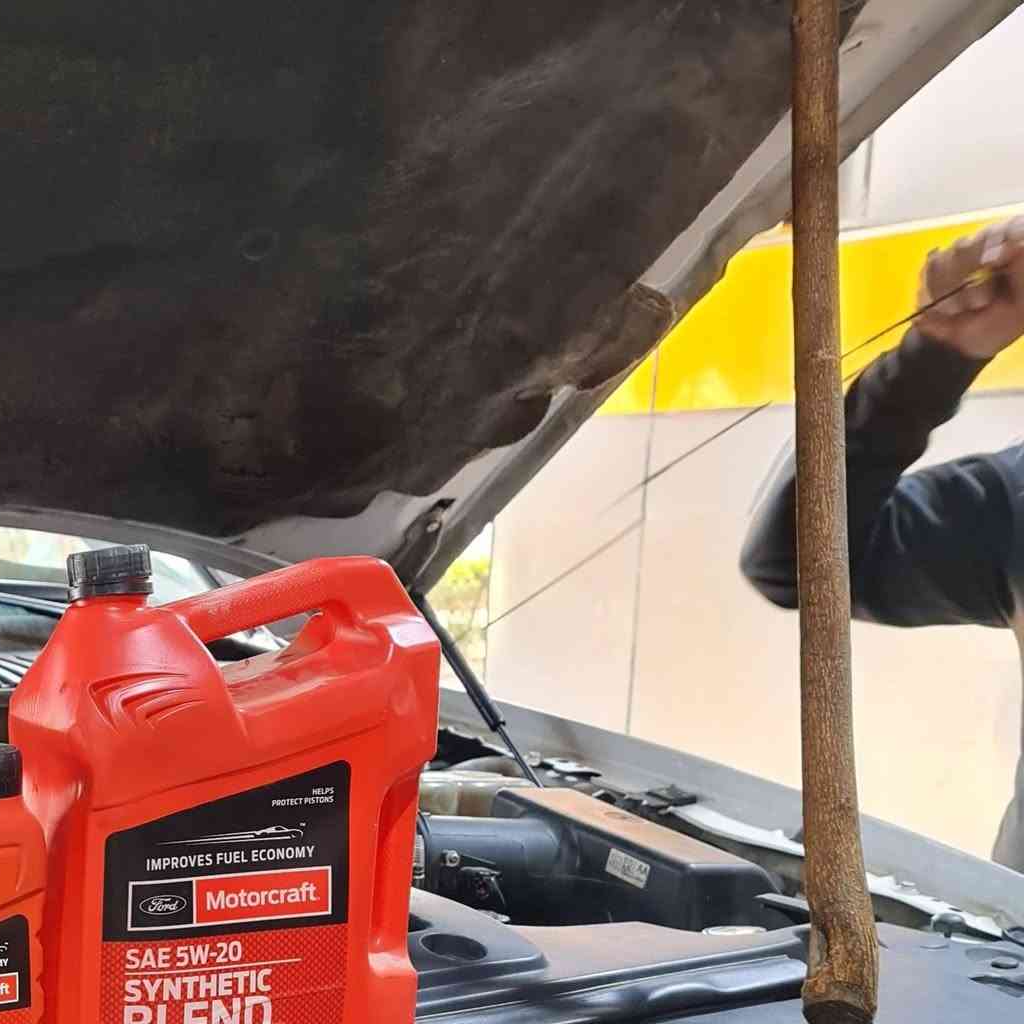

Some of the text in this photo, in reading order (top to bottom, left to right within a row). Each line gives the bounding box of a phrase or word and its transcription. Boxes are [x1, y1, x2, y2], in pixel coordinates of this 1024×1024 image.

[271, 795, 335, 807] PROTECT PISTONS
[312, 787, 335, 796] HELPS
[146, 845, 316, 871] IMPROVES FUEL ECONOMY
[147, 895, 180, 913] Ford
[205, 881, 318, 912] Motorcraft
[126, 940, 242, 969] SAE 5W-20
[124, 968, 273, 1003] SYNTHETIC
